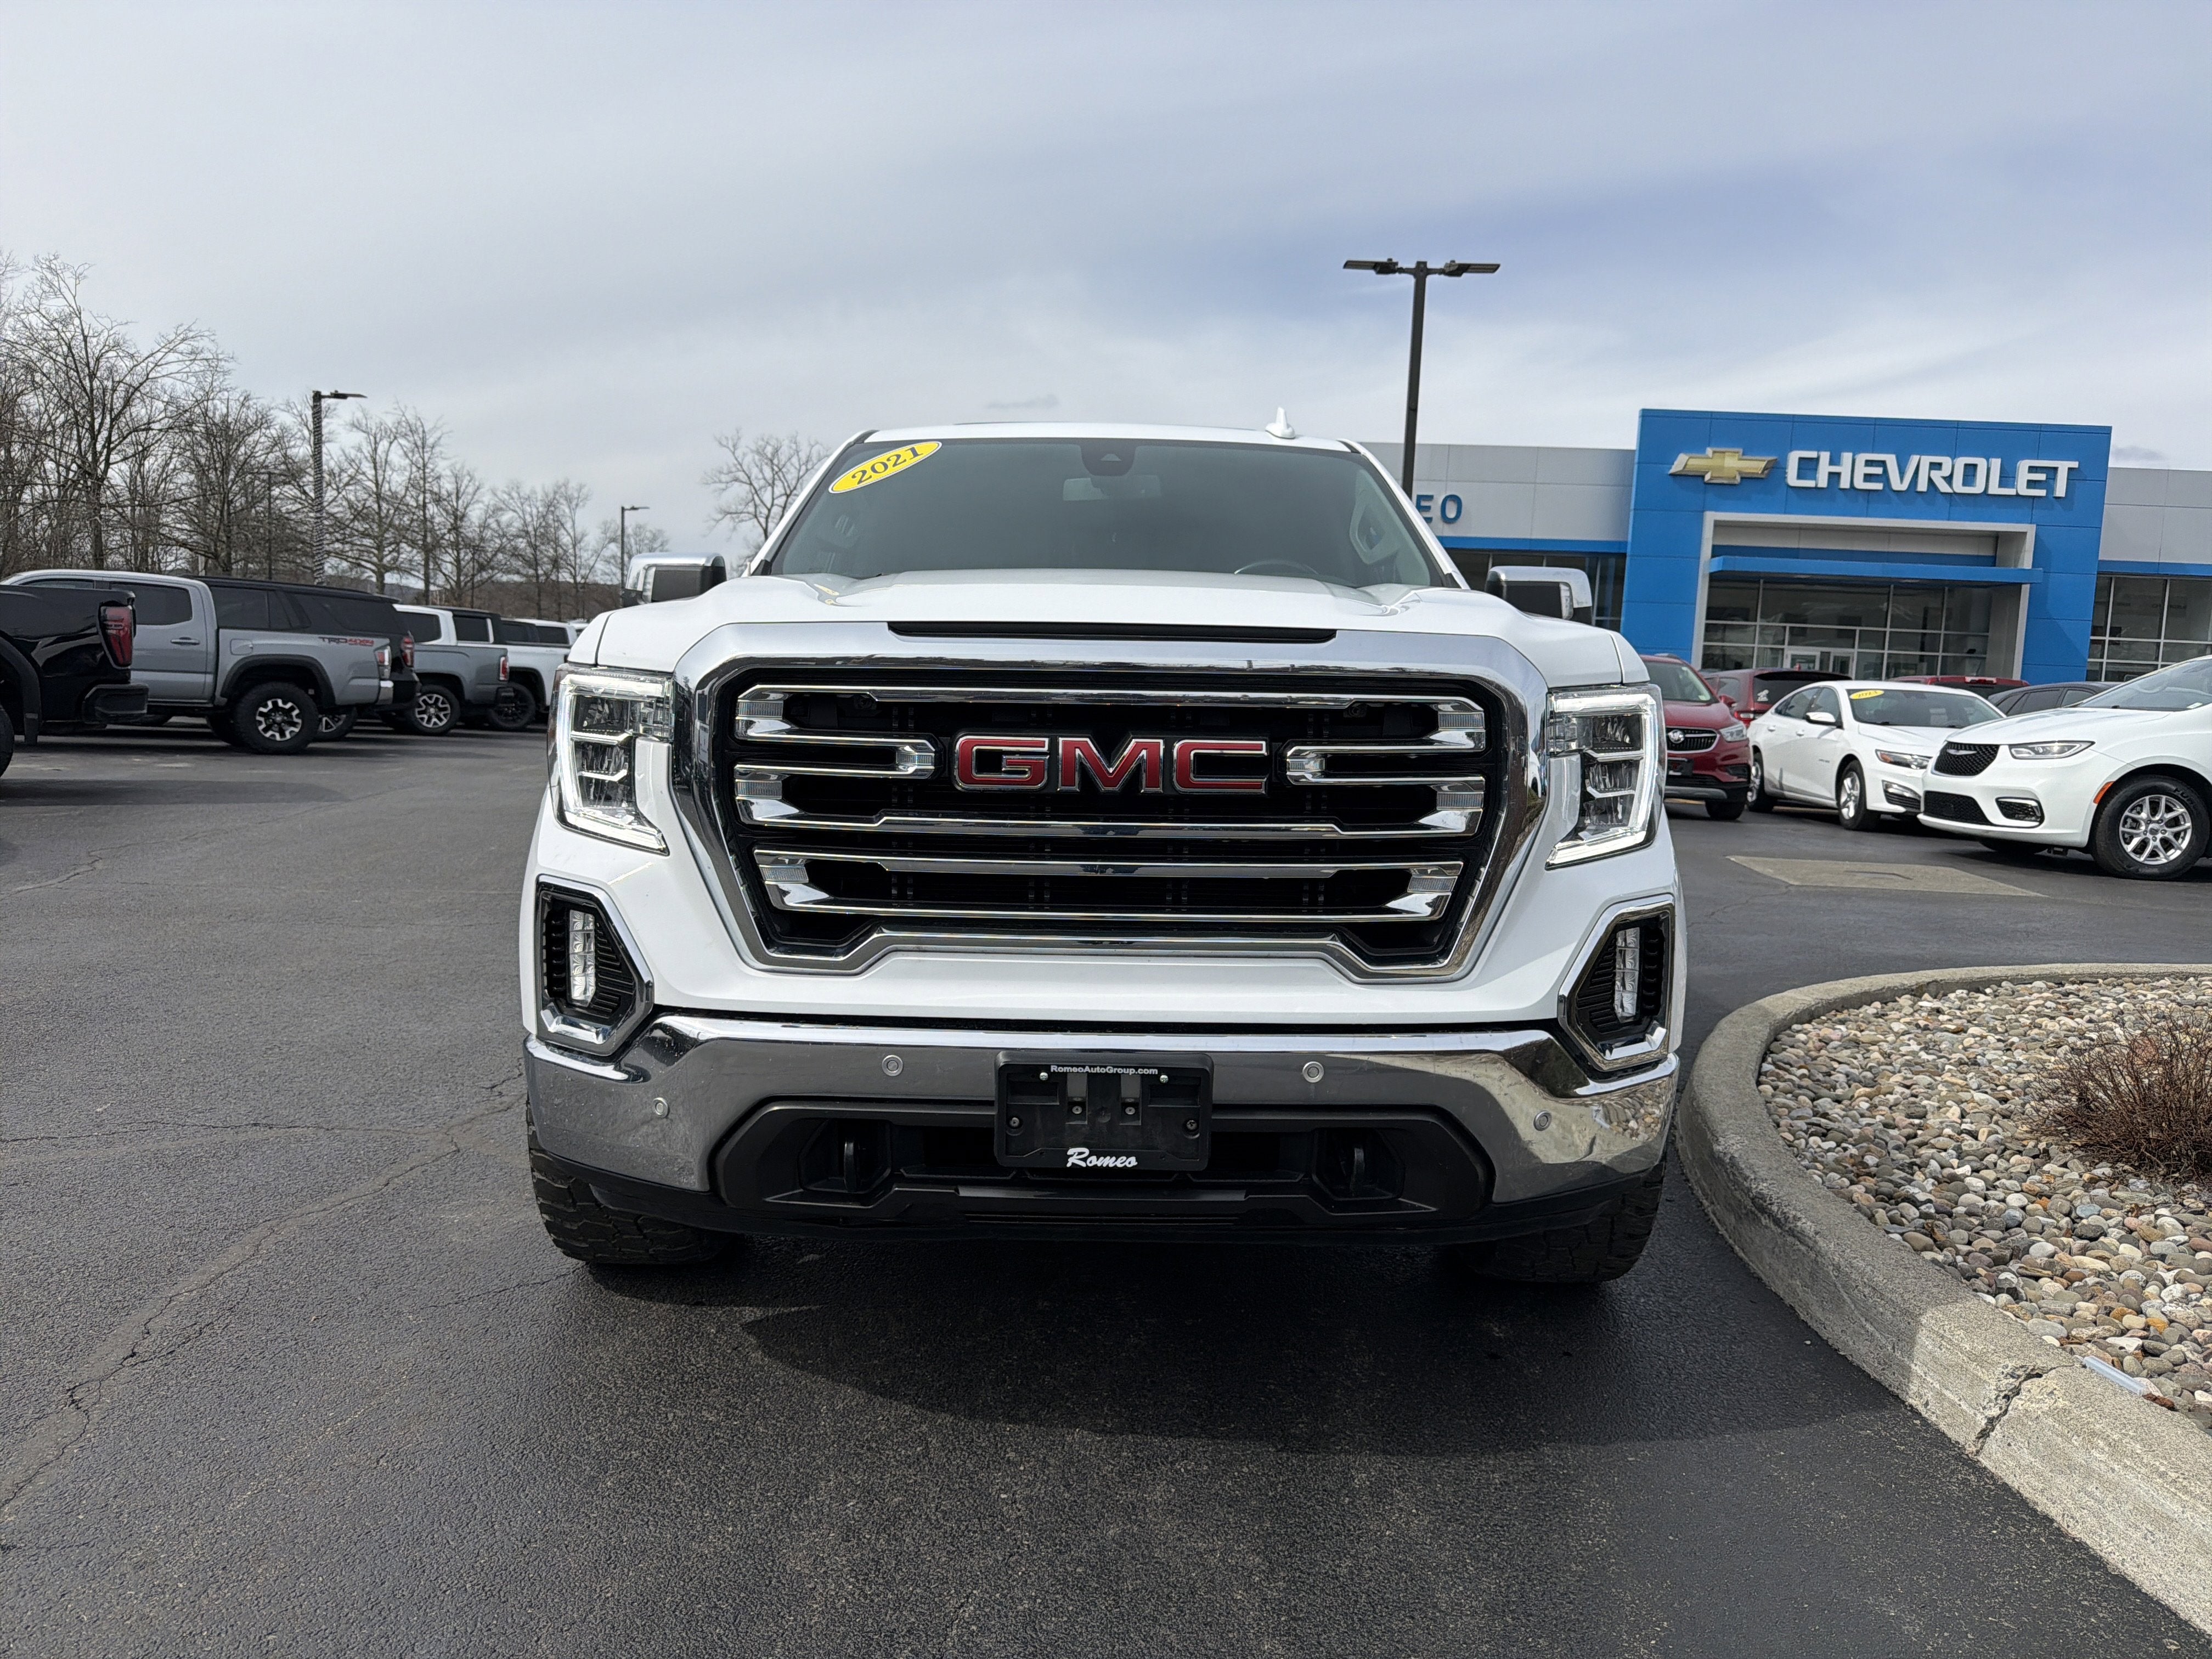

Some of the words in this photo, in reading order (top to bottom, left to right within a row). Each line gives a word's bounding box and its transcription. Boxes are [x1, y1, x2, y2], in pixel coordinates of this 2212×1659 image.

[851, 447, 923, 484] 2021
[1786, 450, 2079, 498] CHEVROLET
[954, 735, 1268, 794] GMC
[1050, 1065, 1158, 1075] RomeoAutoGroup.com
[1066, 1147, 1138, 1167] Romeo
